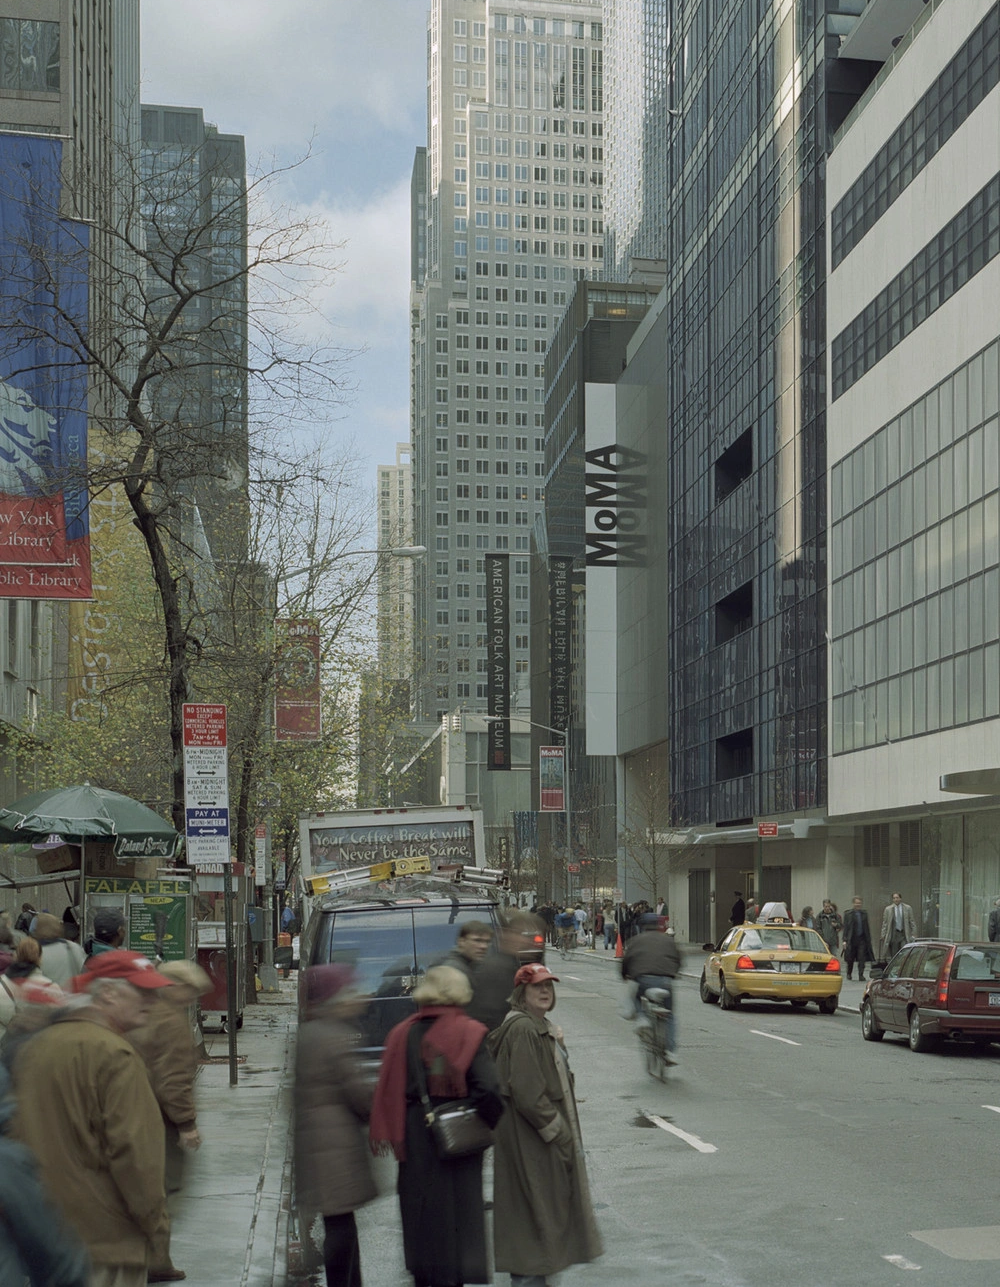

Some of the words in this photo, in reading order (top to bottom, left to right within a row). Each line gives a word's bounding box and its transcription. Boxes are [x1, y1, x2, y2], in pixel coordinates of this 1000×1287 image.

[66, 434, 80, 519] Bibteca
[585, 444, 616, 567] MoMA
[19, 510, 54, 526] York
[0, 532, 54, 552] Library
[29, 572, 82, 590] Library
[492, 560, 504, 624] AMERICAN
[494, 628, 504, 660] FOLK
[494, 664, 504, 690] ART
[494, 694, 504, 748] MUSEUM
[541, 749, 563, 757] MoMA
[313, 832, 344, 846] Your
[351, 830, 394, 846] Coffee
[400, 828, 437, 843] Break
[442, 827, 468, 840] will
[340, 847, 378, 862] Never
[382, 846, 398, 858] be
[404, 844, 428, 857] the
[85, 879, 188, 894] FALAFEL
